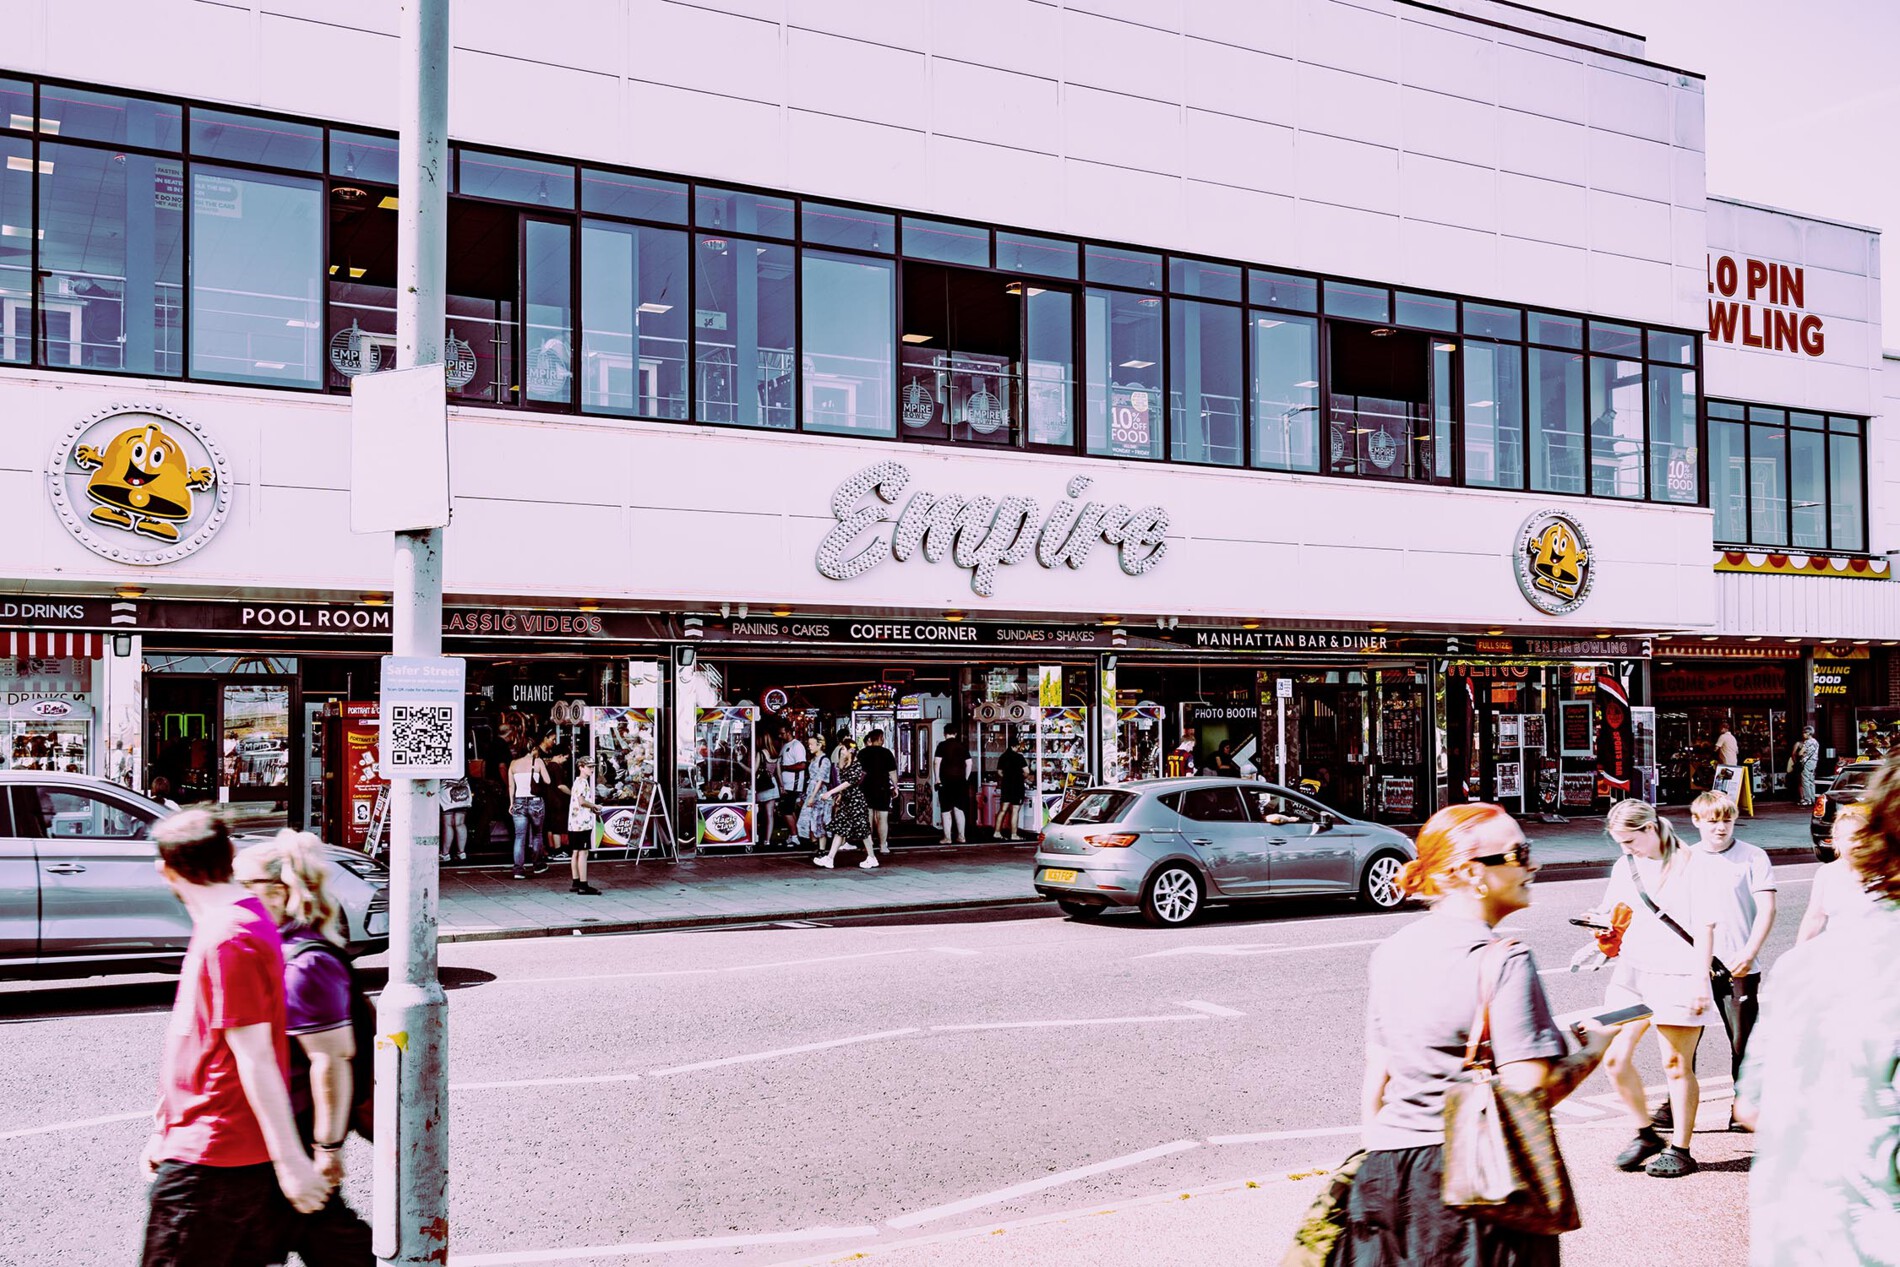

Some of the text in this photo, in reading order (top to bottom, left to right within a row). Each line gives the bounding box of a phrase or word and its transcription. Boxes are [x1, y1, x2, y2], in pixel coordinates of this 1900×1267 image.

[1747, 258, 1804, 309] PIN
[332, 349, 378, 362] EMPIE
[340, 360, 362, 368] BOW
[445, 360, 474, 372] PIRE
[903, 404, 932, 414] MPIRE
[968, 410, 1000, 420] EMPIRE
[1132, 422, 1147, 430] OFF
[1112, 429, 1148, 443] FOOD
[1668, 478, 1693, 490] FOOD
[816, 459, 1169, 597] Empire
[22, 604, 84, 619] DRINKS
[242, 608, 389, 628] POOL ROOM
[442, 613, 602, 634] ASSIC VIDEOS
[732, 623, 829, 636] PANINIS CAKES
[850, 624, 977, 640] COFFEE CORNER
[997, 630, 1094, 642] SUNDAES SHAKES
[1197, 632, 1388, 648] MANHATTAN BAR & DINER
[1526, 640, 1628, 654] TEN PIN BOWLING
[387, 665, 460, 676] Safer Street
[1814, 666, 1850, 674] WLING
[513, 685, 554, 702] CHANGE
[1814, 685, 1847, 694] RINKS
[1195, 708, 1257, 718] PHOTO BOOTH
[1613, 731, 1622, 760] SPORTS
